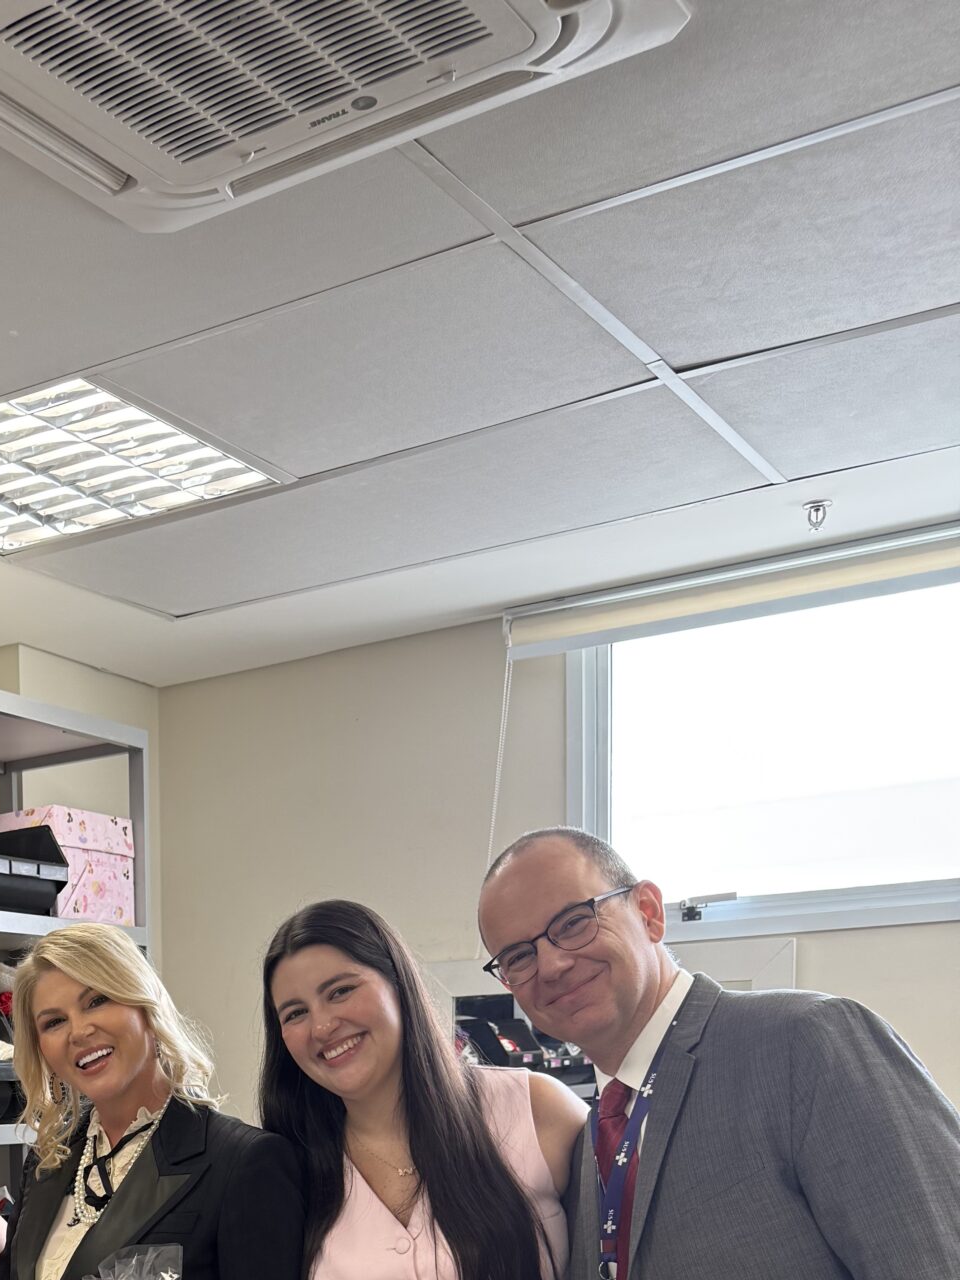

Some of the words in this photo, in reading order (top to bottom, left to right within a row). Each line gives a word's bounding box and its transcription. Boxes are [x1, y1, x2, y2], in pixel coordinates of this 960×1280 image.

[309, 108, 349, 128] TRANE
[648, 1072, 657, 1084] SUS
[621, 1141, 630, 1152] SUS
[607, 1208, 615, 1220] SUS
